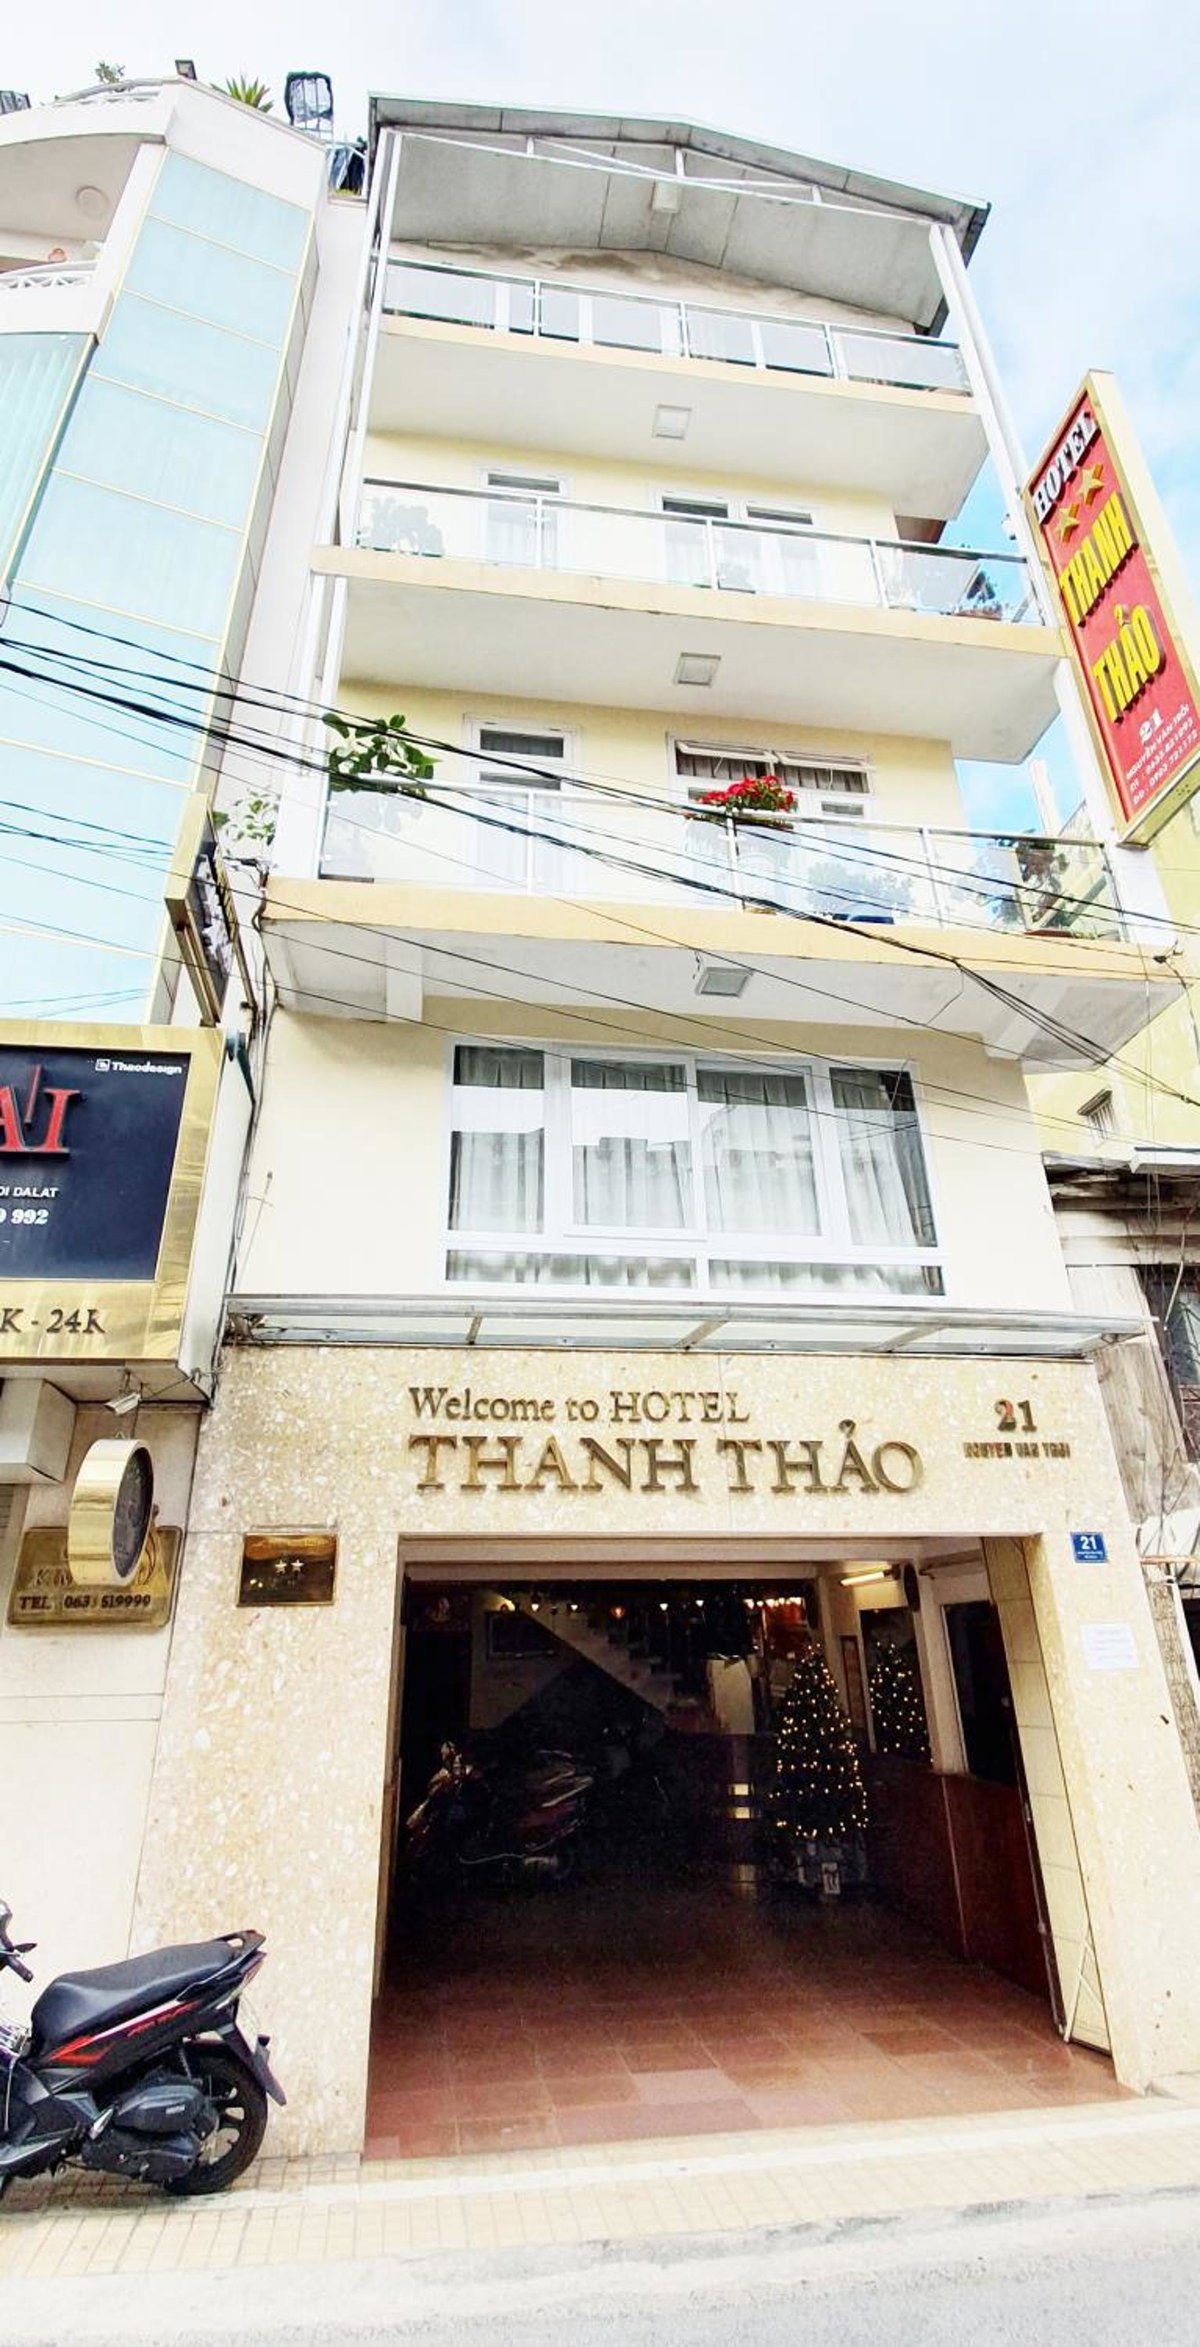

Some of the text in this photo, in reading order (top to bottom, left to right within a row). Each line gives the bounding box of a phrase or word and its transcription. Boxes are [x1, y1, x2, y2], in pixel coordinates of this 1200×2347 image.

[1033, 411, 1100, 524] HOTEL
[1060, 492, 1136, 627] THANH
[1093, 603, 1163, 723] THẢO
[1140, 708, 1163, 745] 21
[13, 1186, 59, 1198] DALAT
[10, 1208, 49, 1225] 992
[46, 1308, 106, 1335] 24K
[408, 1386, 750, 1424] Welcome to HOTEL
[994, 1399, 1037, 1432] 21
[408, 1418, 924, 1495] THANH THẢO
[1080, 1535, 1097, 1550] 21
[20, 1595, 52, 1610] TEL
